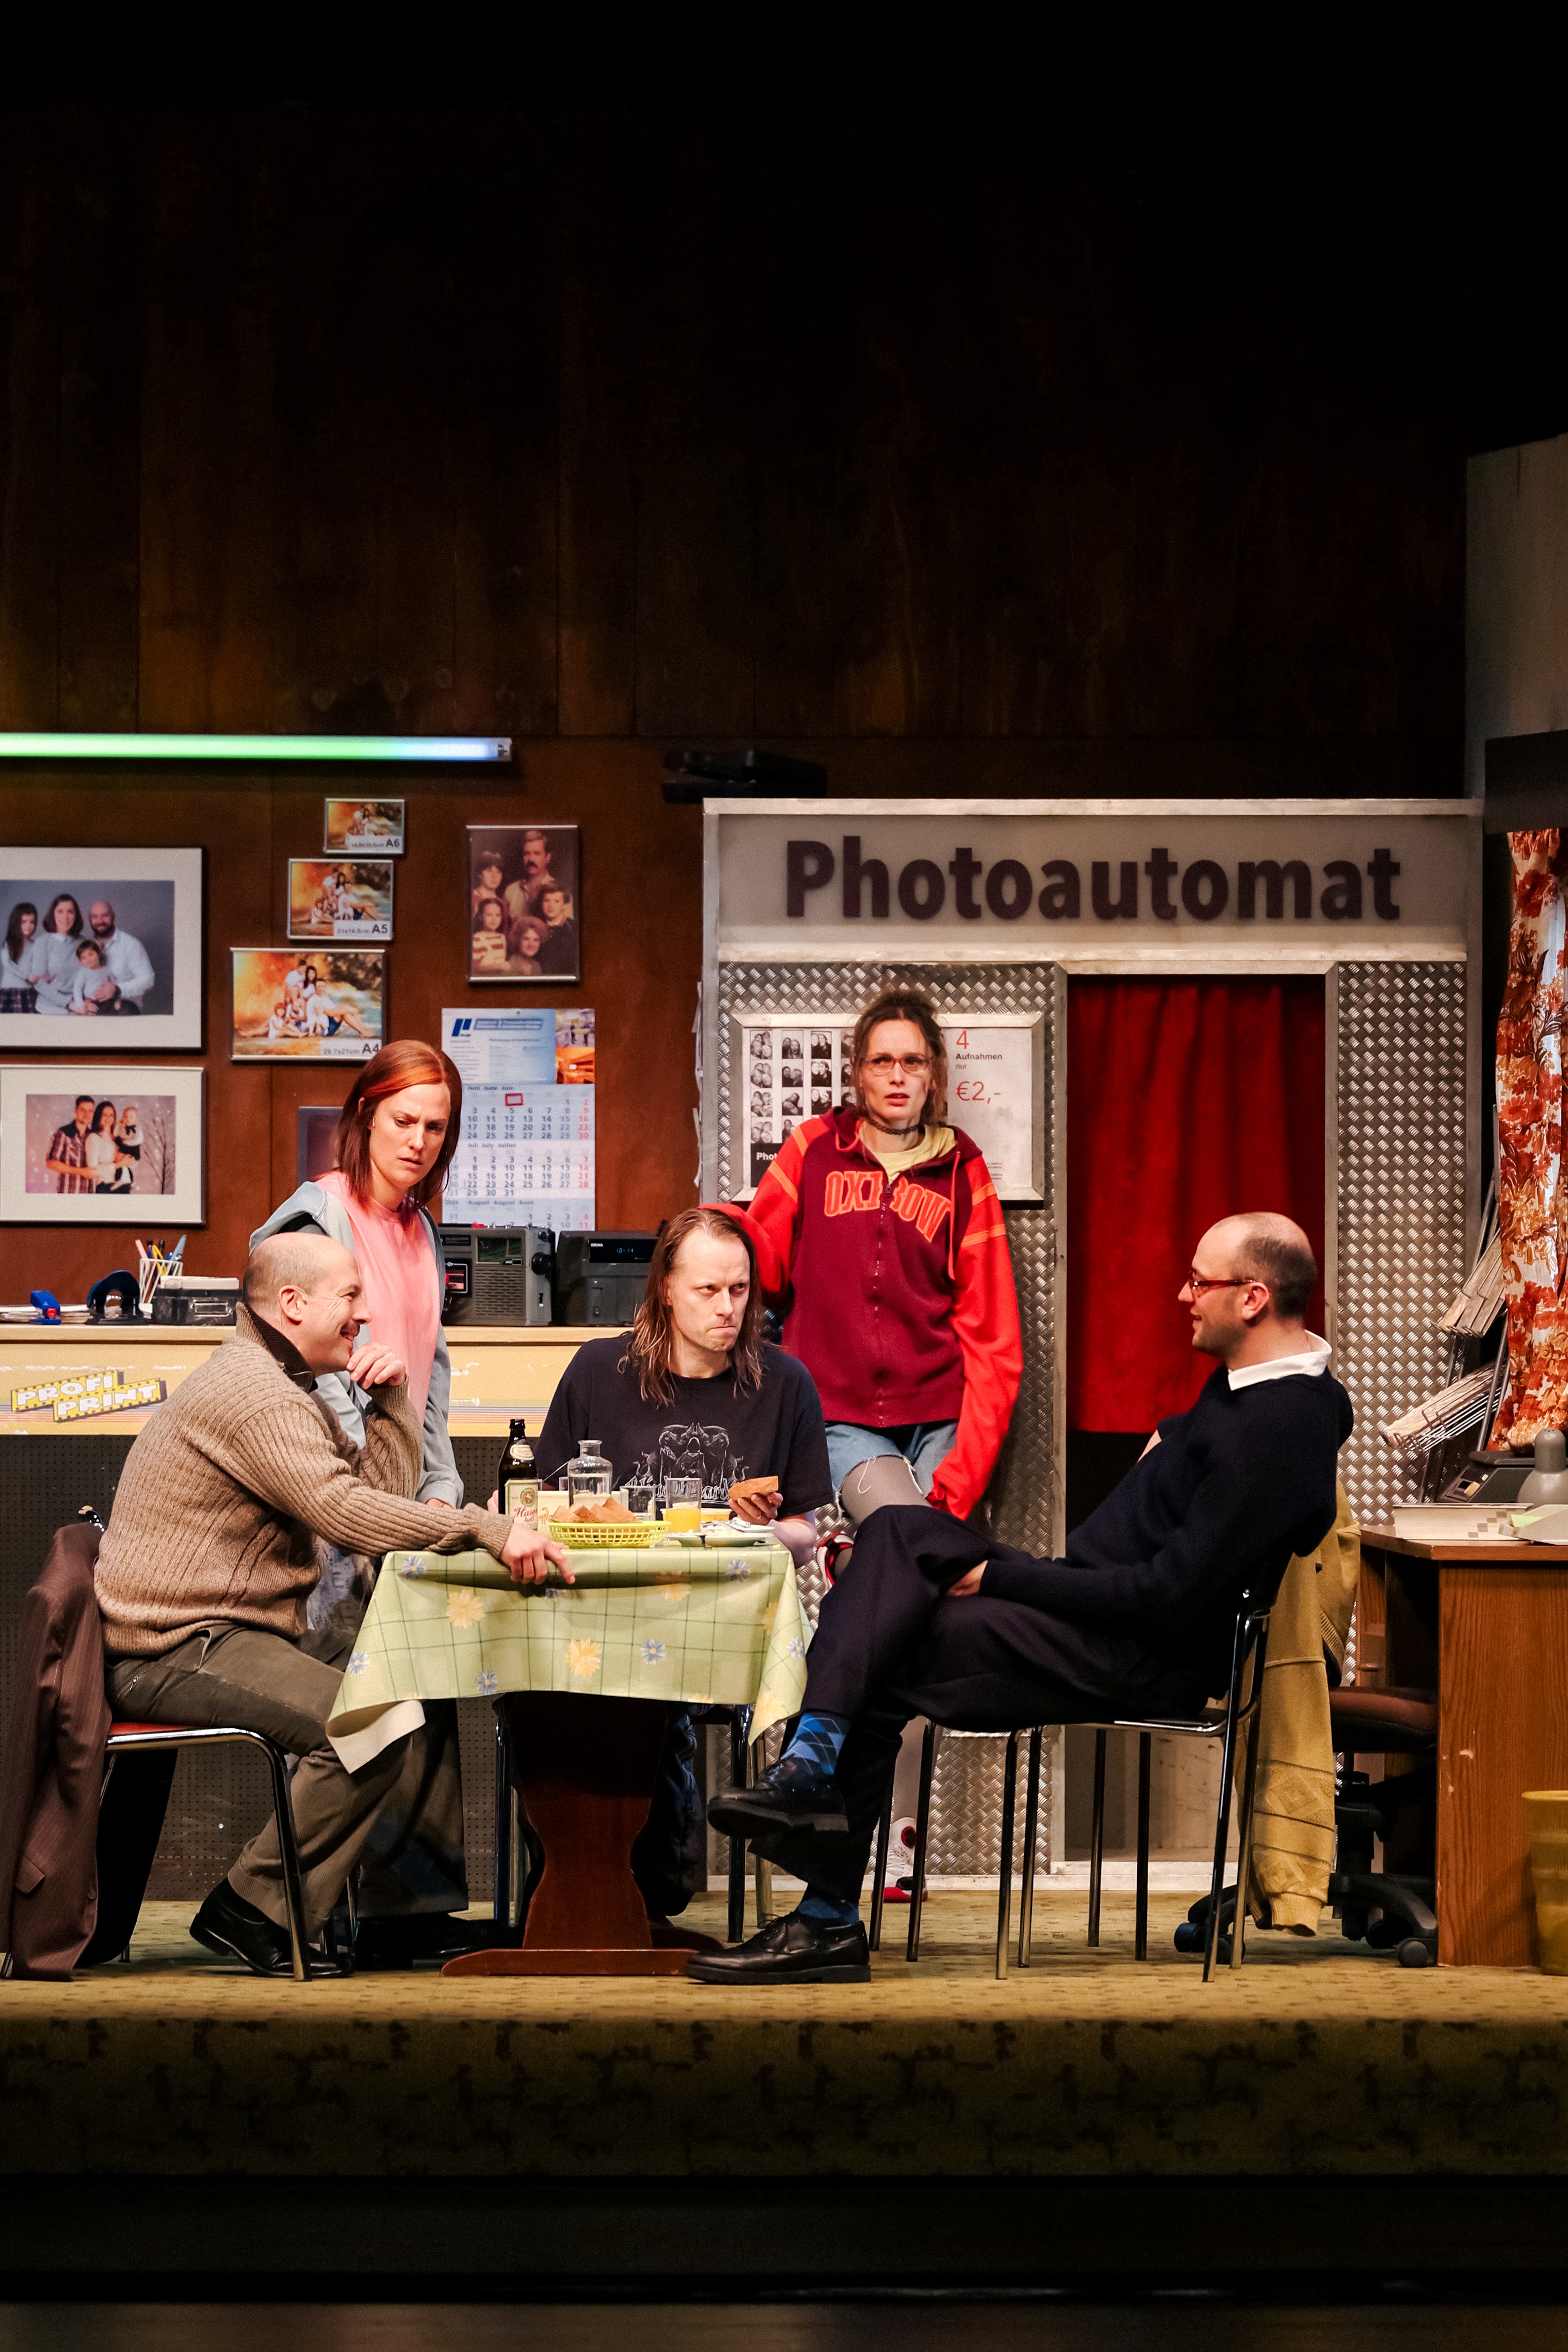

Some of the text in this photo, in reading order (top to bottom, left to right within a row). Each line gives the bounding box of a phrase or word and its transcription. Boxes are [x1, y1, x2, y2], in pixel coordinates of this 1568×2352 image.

[386, 838, 400, 847] A6
[787, 835, 1401, 920] Photoautomat
[372, 924, 388, 934] A5
[362, 1043, 380, 1054] A4
[956, 1030, 969, 1050] 4
[17, 1374, 114, 1406] PROFI
[57, 1384, 158, 1417] PRINT
